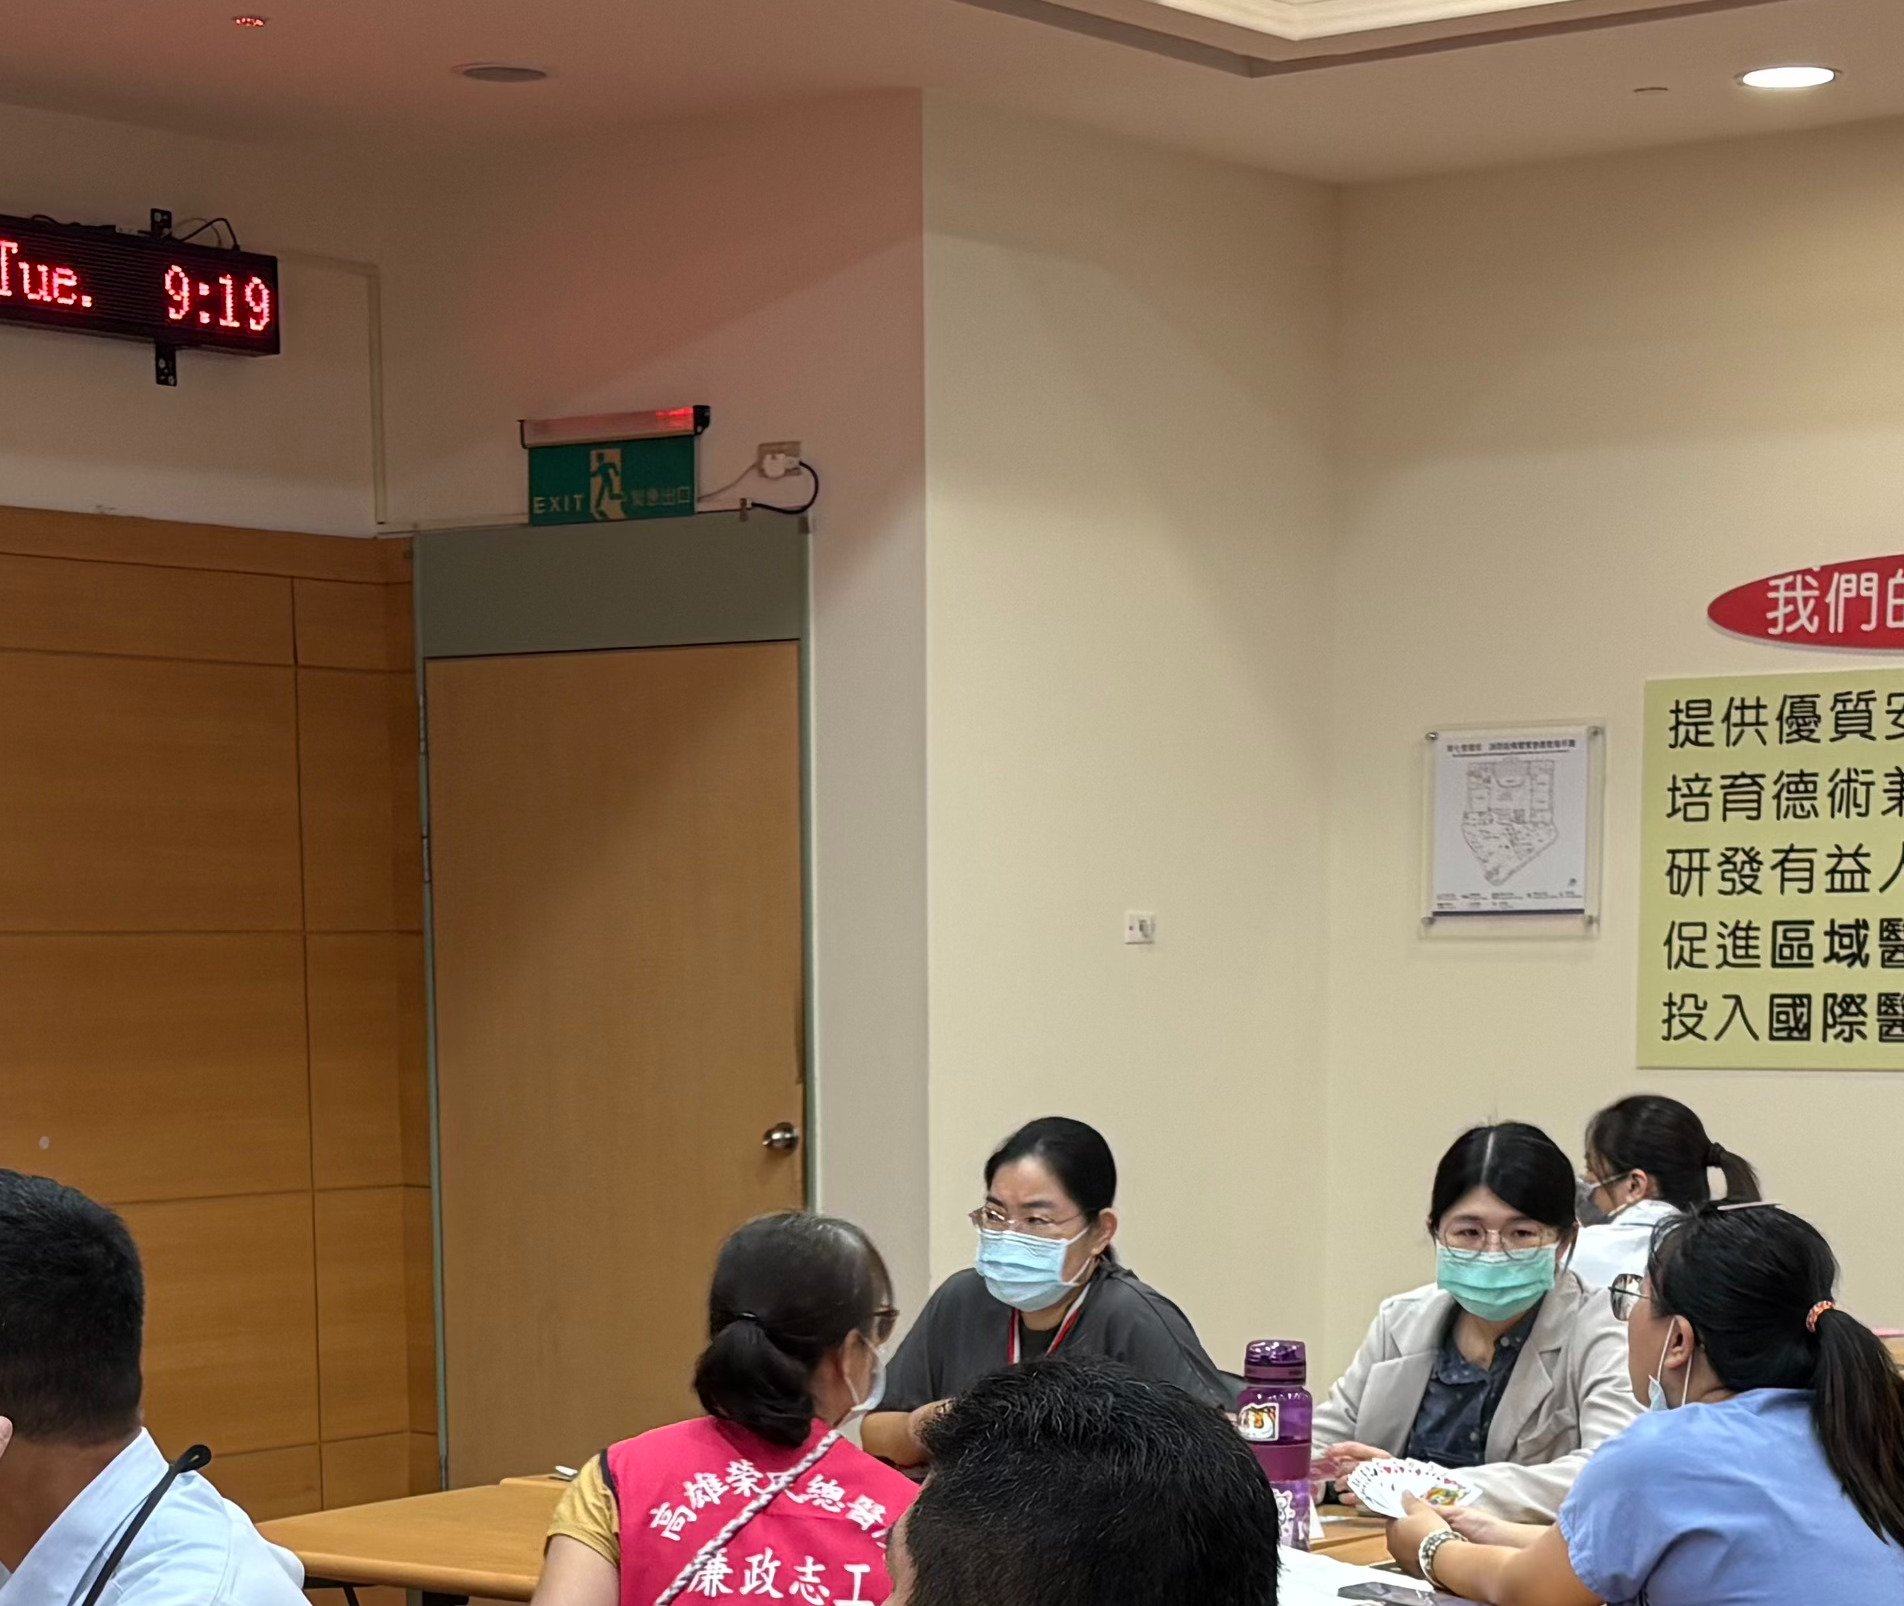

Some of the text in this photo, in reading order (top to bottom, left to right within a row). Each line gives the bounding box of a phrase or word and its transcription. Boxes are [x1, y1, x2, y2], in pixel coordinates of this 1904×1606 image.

[164, 264, 271, 331] 9:19
[532, 493, 584, 515] EXIT
[648, 1458, 890, 1550] 高雄榮總醫
